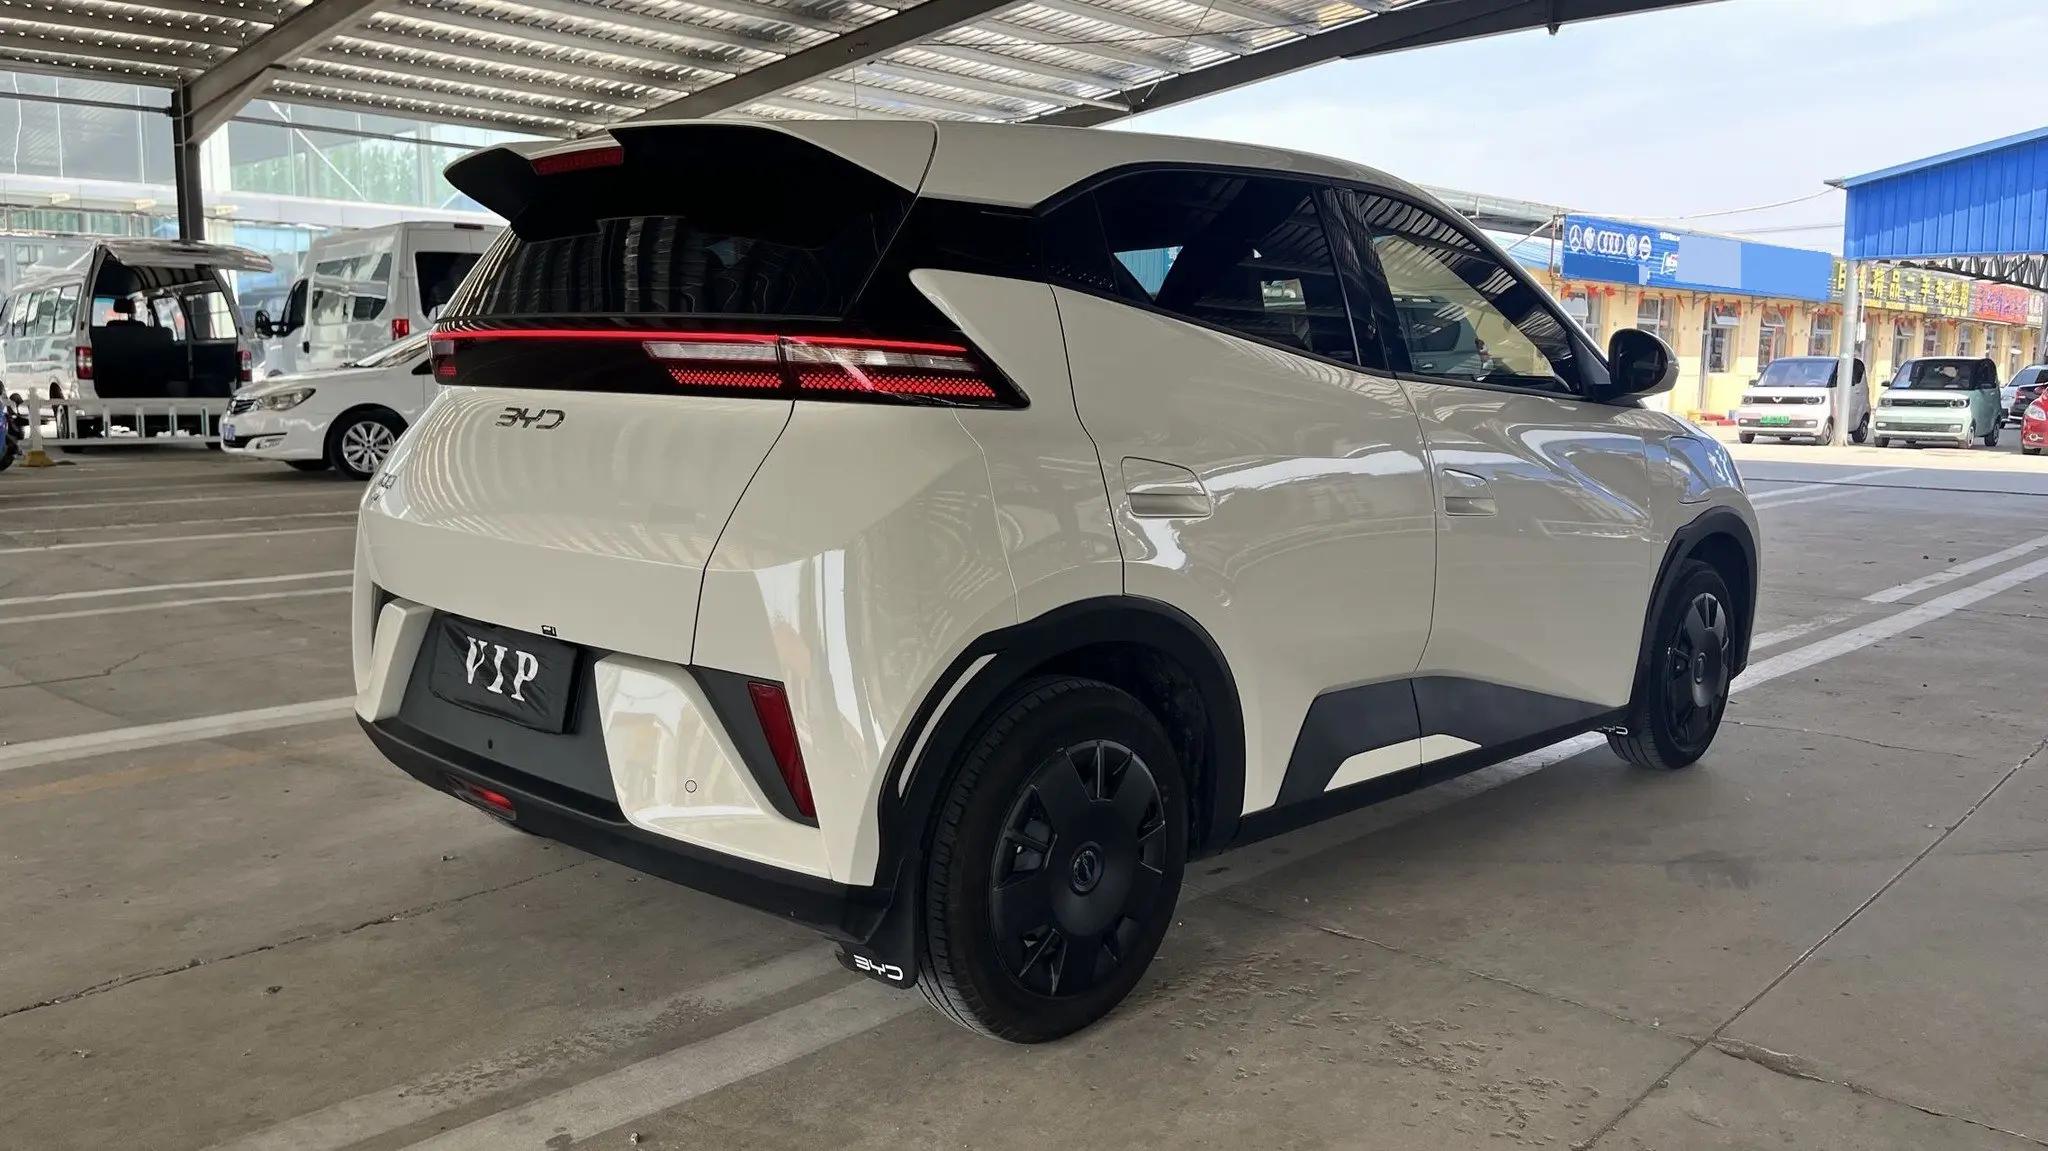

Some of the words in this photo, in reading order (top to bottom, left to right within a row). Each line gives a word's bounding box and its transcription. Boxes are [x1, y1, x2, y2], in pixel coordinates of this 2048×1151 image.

[495, 406, 566, 429] BYD
[466, 636, 538, 702] VIP
[853, 954, 904, 981] BYD
